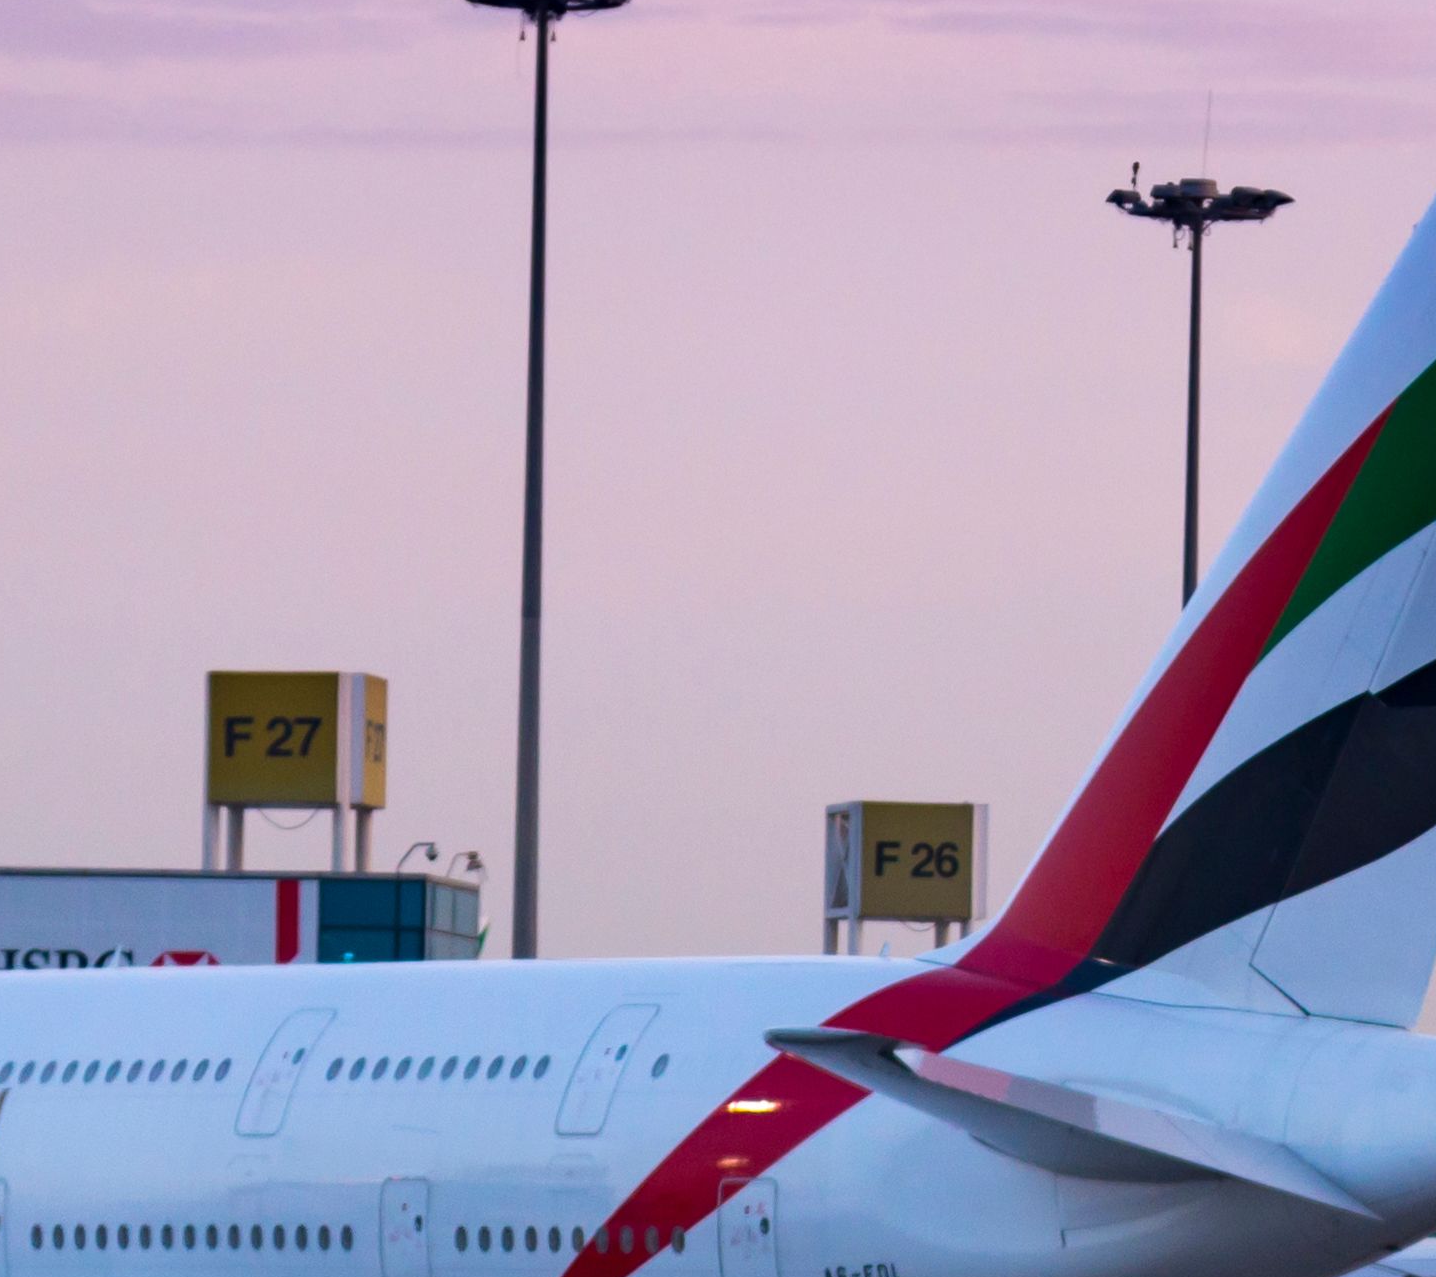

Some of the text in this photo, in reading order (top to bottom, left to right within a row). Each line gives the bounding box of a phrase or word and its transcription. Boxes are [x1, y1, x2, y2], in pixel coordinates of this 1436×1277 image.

[224, 716, 322, 758] F 27
[875, 841, 960, 878] F 26
